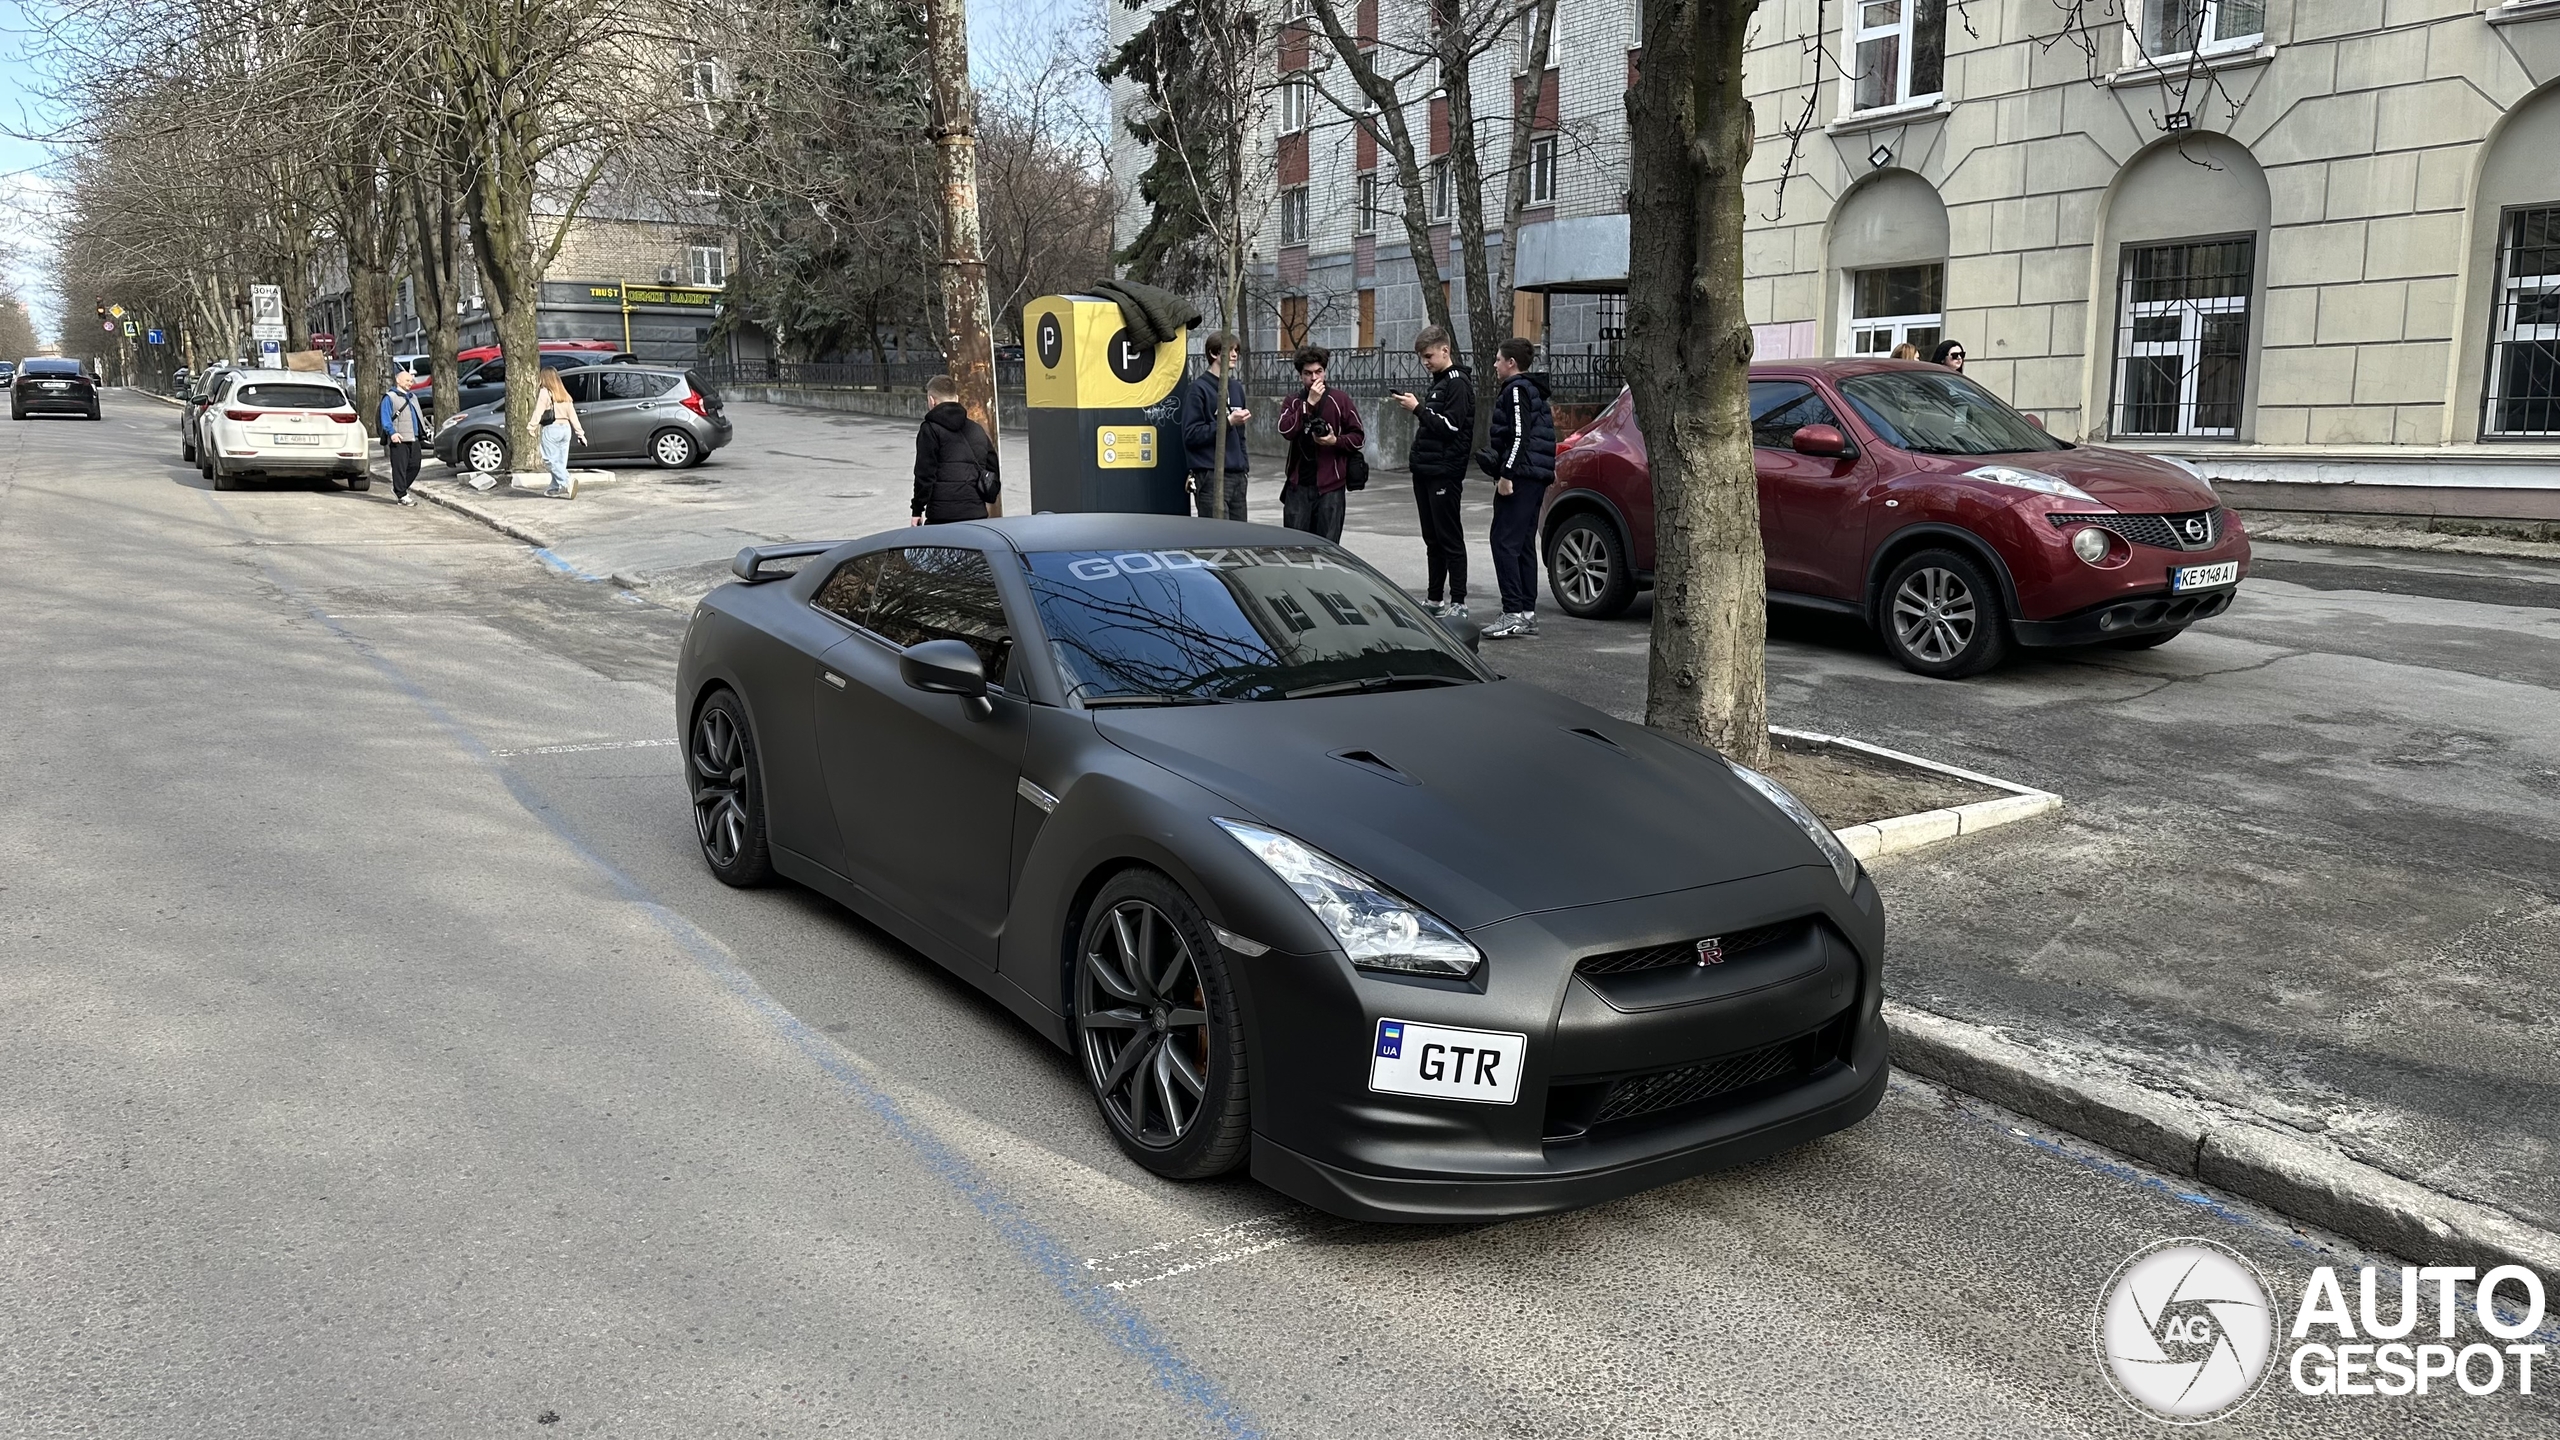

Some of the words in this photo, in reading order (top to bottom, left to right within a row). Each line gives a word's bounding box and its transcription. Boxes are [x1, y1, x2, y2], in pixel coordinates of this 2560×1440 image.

[253, 287, 279, 295] ЗОНА
[1068, 548, 1352, 582] GODZILLA
[2181, 570, 2197, 586] KE
[2199, 567, 2221, 585] 9148
[1383, 1045, 1398, 1056] UA
[1419, 1043, 1501, 1087] GTR
